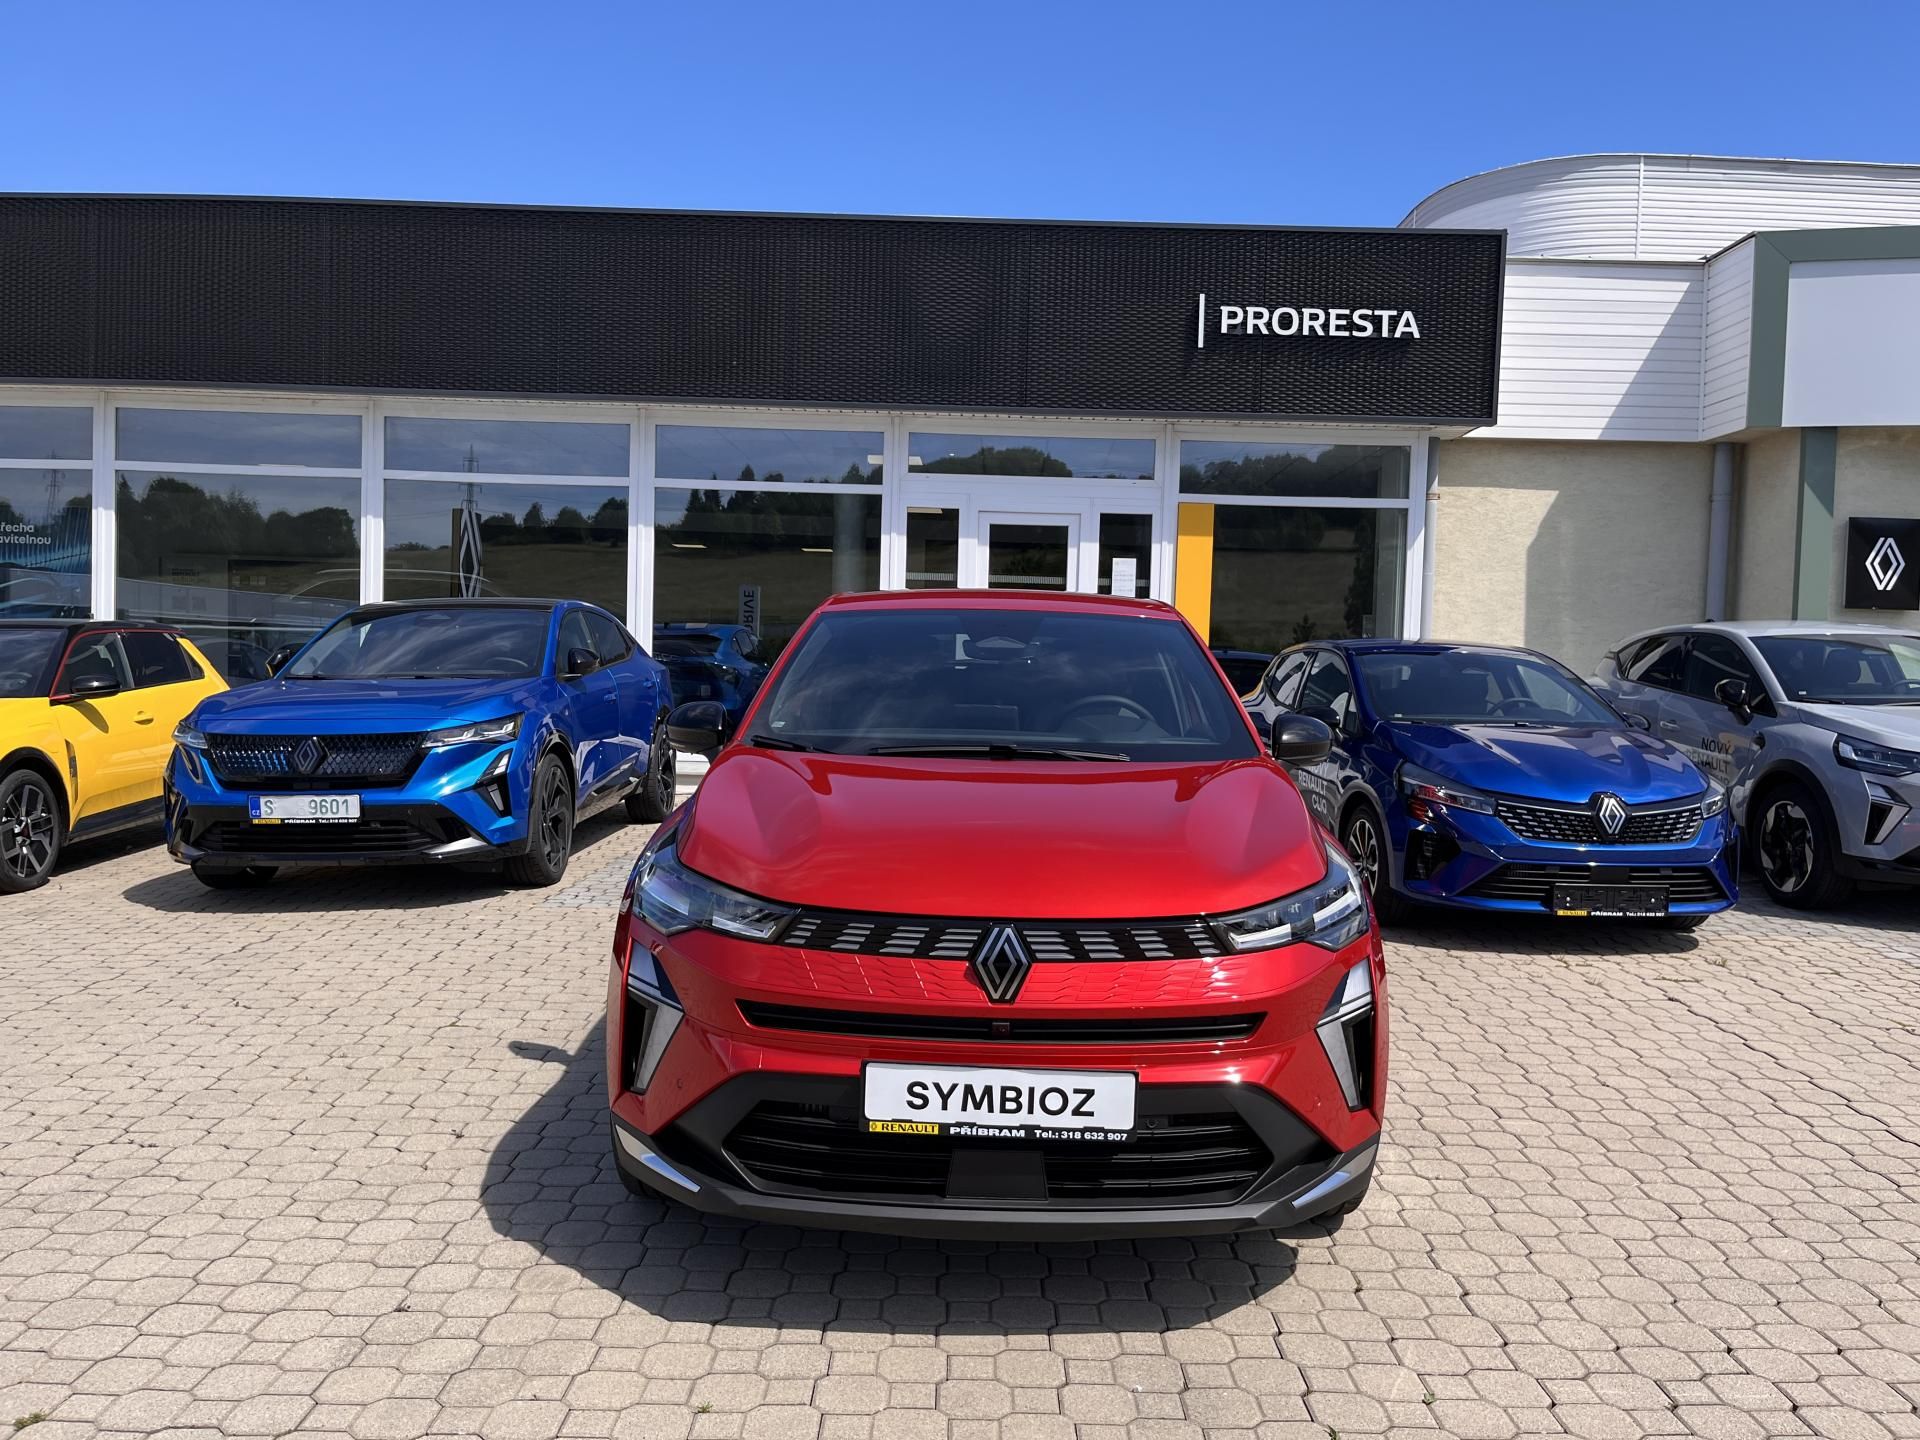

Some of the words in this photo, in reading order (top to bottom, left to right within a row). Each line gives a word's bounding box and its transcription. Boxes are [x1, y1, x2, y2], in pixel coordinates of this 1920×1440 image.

[1219, 305, 1421, 339] PRORESTA
[0, 521, 35, 533] řecha
[0, 534, 52, 545] avitelnou
[1701, 736, 1732, 755] NOVÝ
[1297, 770, 1328, 797] RENAULT
[308, 798, 350, 816] 9601
[906, 1080, 1096, 1118] SYMBIOZ
[881, 1123, 938, 1134] RENAULT
[950, 1125, 1025, 1138] PŘÍBRAM
[1034, 1129, 1059, 1139] Tel.:
[1060, 1130, 1081, 1140] 318
[1084, 1131, 1104, 1140] 632
[1107, 1132, 1128, 1141] 907
